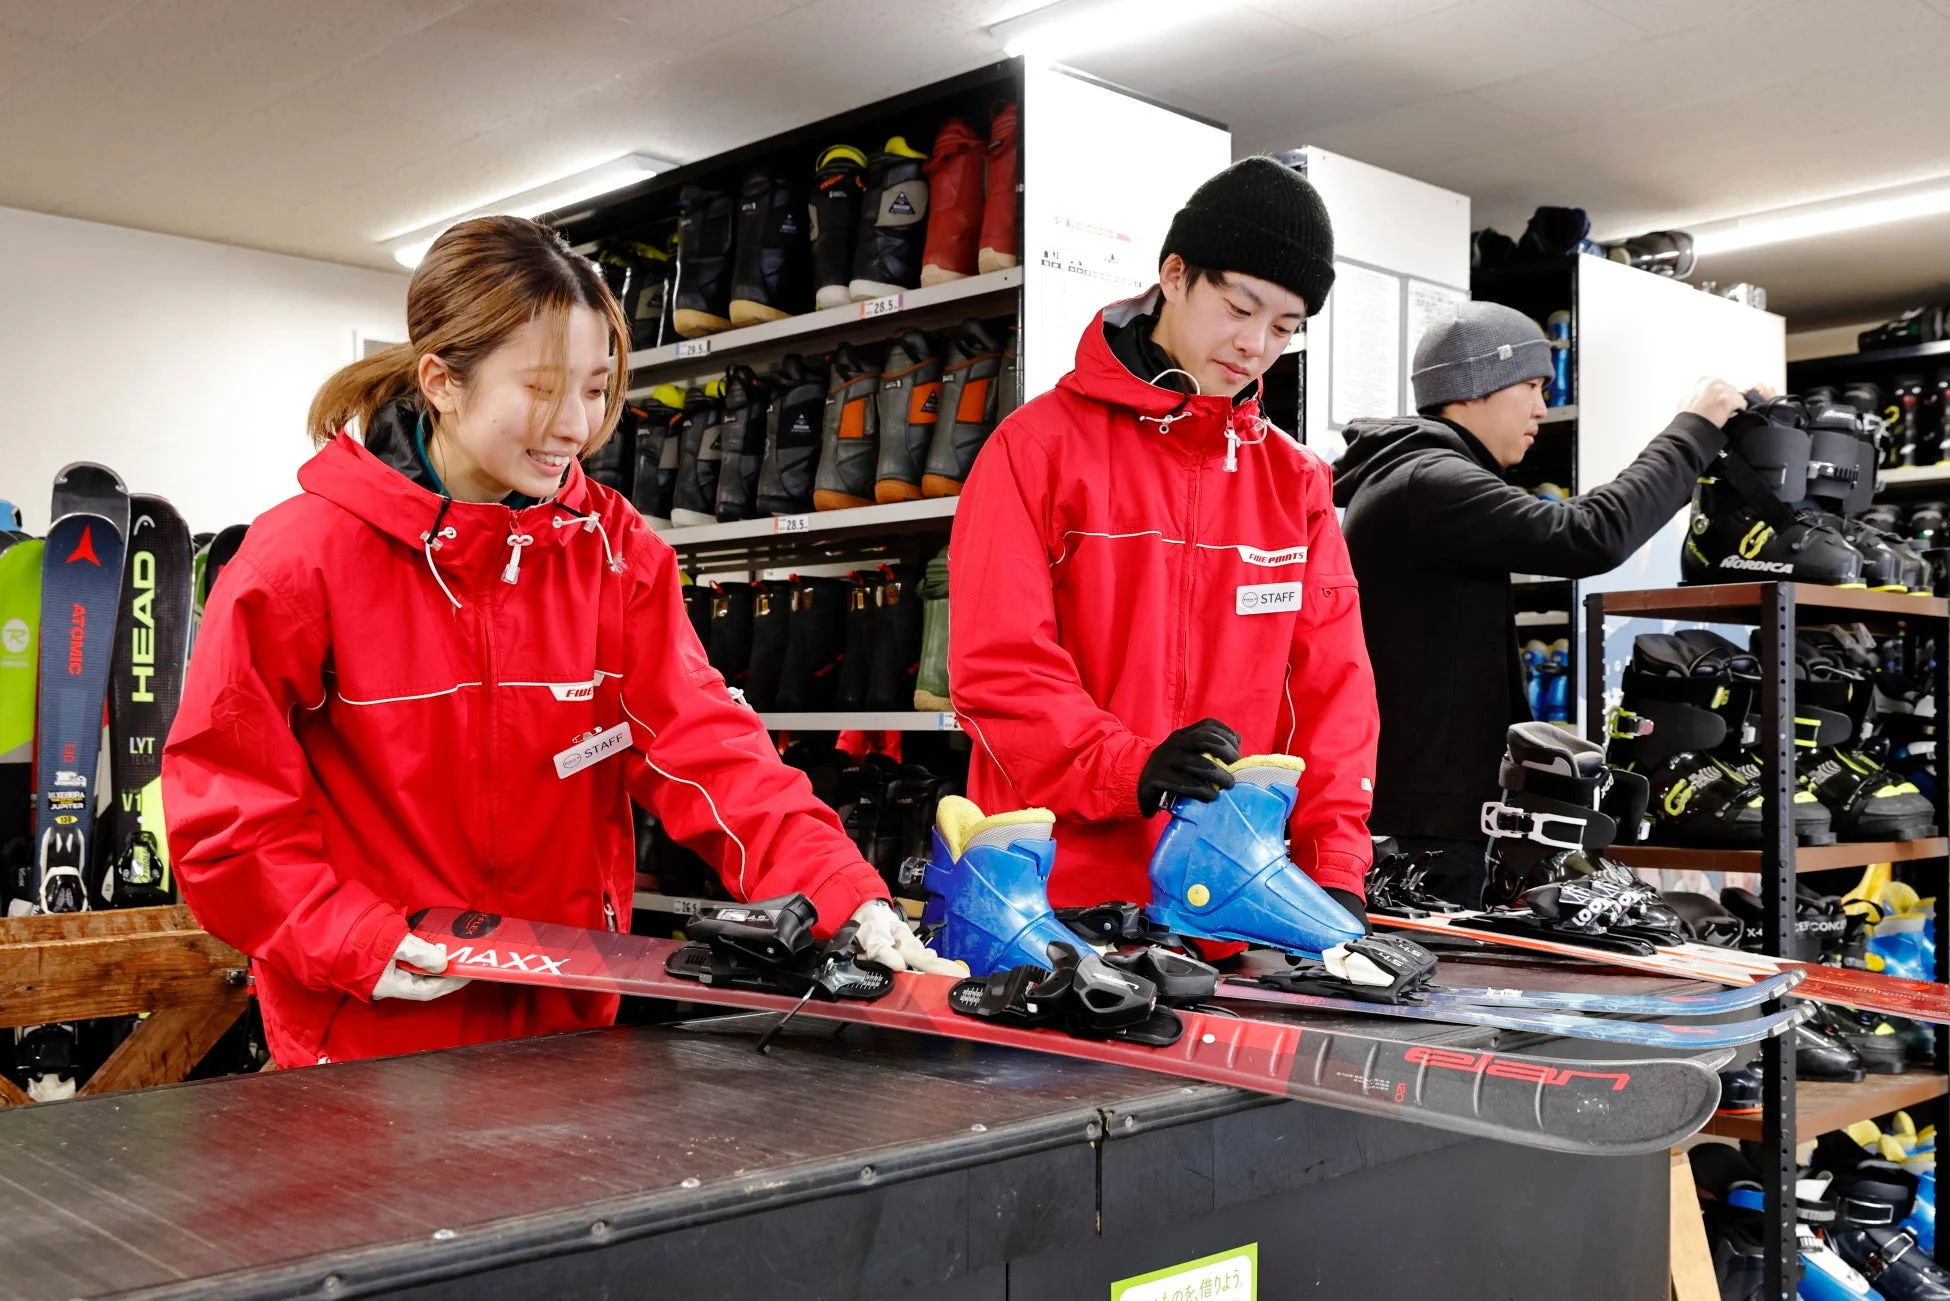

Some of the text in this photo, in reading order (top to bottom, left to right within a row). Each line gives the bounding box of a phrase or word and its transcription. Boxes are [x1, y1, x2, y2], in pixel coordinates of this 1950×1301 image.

[874, 300, 894, 314] 28.5
[786, 519, 804, 531] 28.5
[1268, 552, 1305, 564] POINTS
[1719, 555, 1795, 574] NORDICA
[1260, 592, 1296, 604] STAFF
[132, 550, 155, 702] HEAD
[68, 603, 87, 676] ATOMIC
[129, 737, 155, 754] LYT
[584, 732, 624, 759] STAFF
[447, 946, 572, 976] MAXX
[1404, 1046, 1631, 1091] elan
